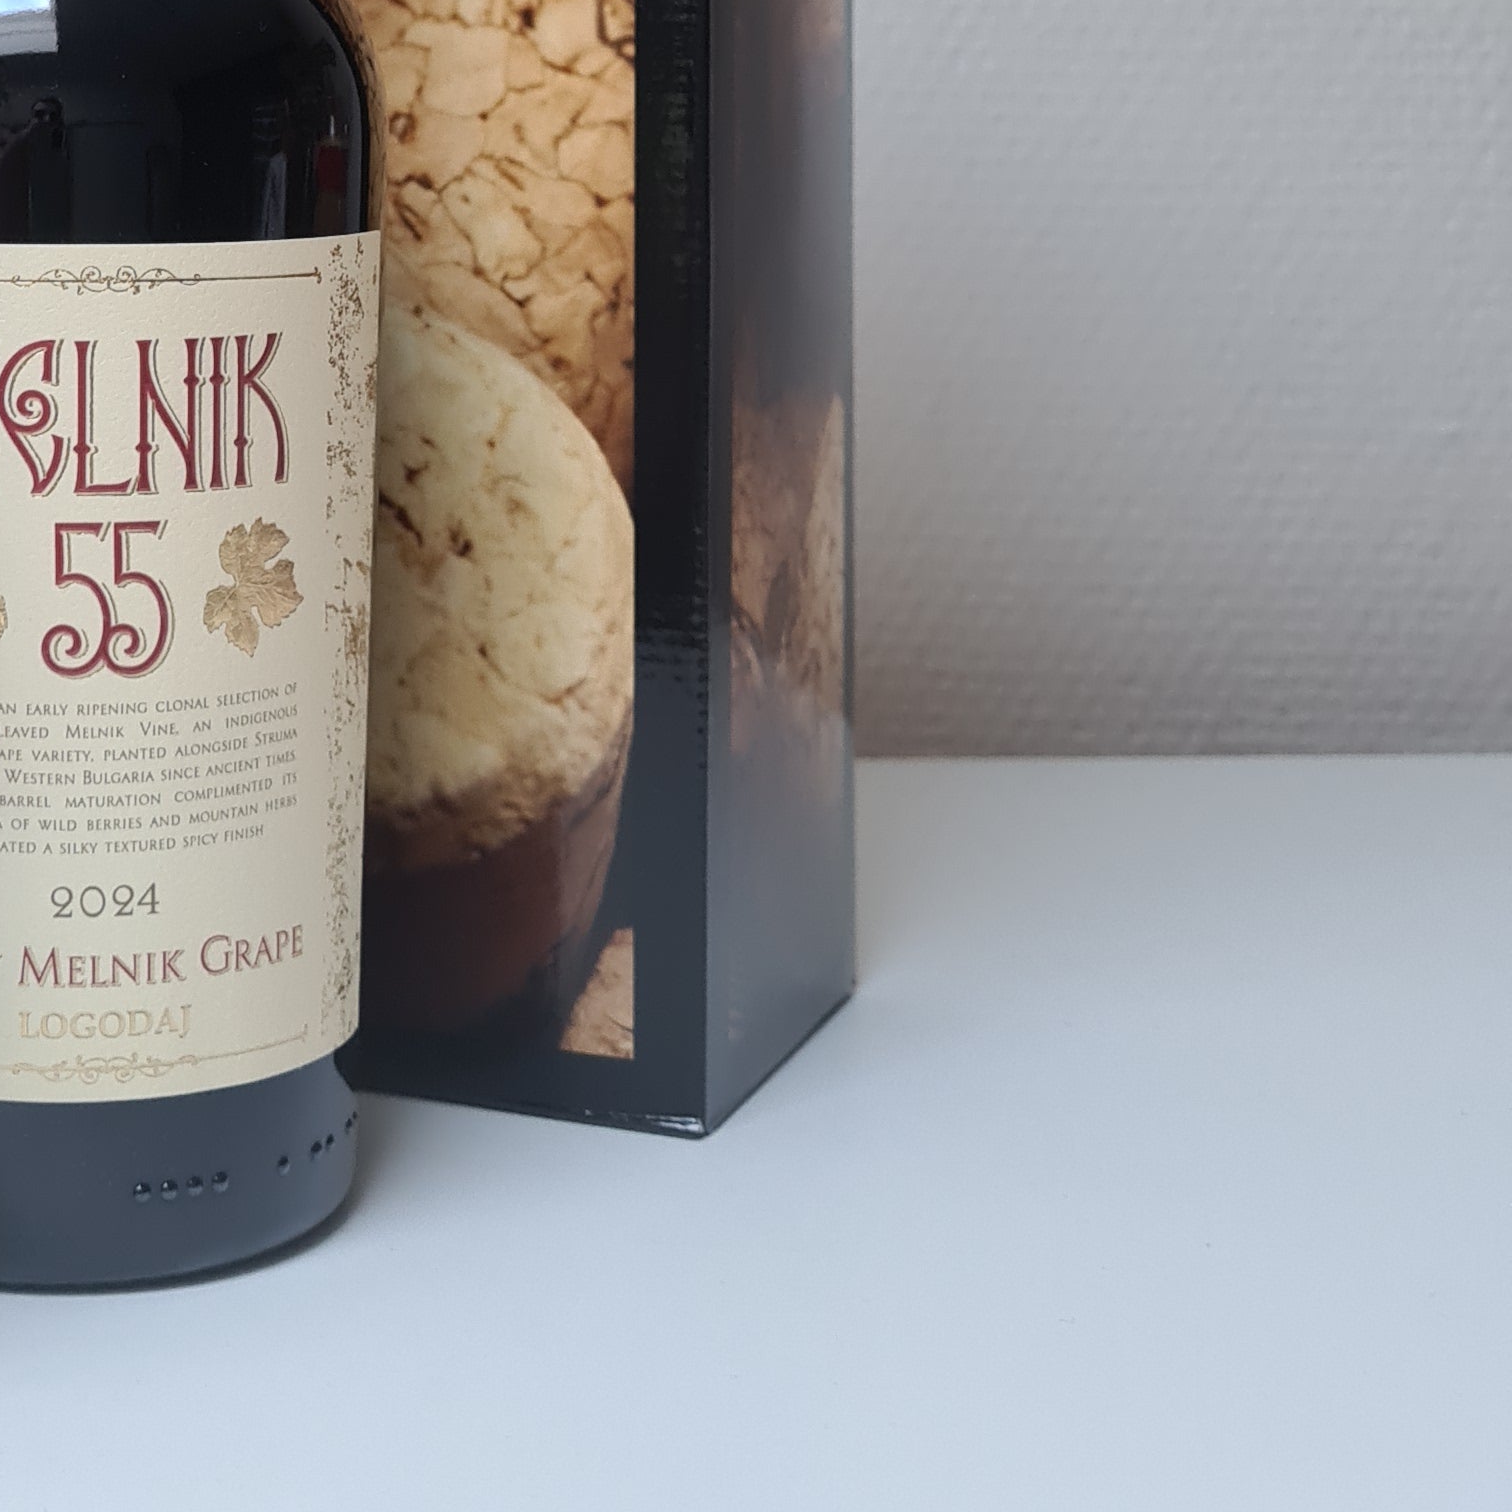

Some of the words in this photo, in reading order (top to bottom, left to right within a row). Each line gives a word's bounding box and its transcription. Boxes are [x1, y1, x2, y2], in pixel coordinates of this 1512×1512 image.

[41, 519, 175, 679] 55
[26, 704, 68, 716] EARLY
[77, 702, 147, 716] RIPENING
[155, 697, 209, 713] CLONAL
[216, 687, 279, 707] SELECTION
[284, 682, 297, 696] OF
[65, 724, 125, 739] MELNIK
[193, 720, 211, 733] AN
[226, 704, 298, 729] INDIGENOUS
[104, 747, 166, 761] PLANTED
[175, 737, 248, 758] ALONGSIDE
[255, 728, 298, 747] STRUMA
[4, 768, 75, 785] WESTERN
[83, 769, 154, 785] BULGARIA
[161, 766, 200, 782] SINCE
[206, 758, 261, 777] ANCIENT
[267, 750, 296, 768] TIMES
[0, 795, 51, 808] BARREL
[65, 793, 161, 808] MATURATION
[174, 777, 273, 803] COMPLIMENTED
[282, 771, 297, 786] ITS
[11, 818, 30, 831] OF
[38, 819, 77, 832] WILD
[87, 816, 142, 831] BERRIES
[149, 814, 181, 828] AND
[189, 803, 258, 824] MOUNTAIN
[265, 794, 297, 813] HERBS
[43, 842, 53, 854] A
[59, 842, 98, 854] SILKY
[106, 837, 176, 854] TEXTURED
[183, 832, 218, 848] SPICY
[224, 824, 264, 843] FINISH
[50, 883, 160, 918] 2024
[18, 945, 187, 988] MELNIK
[199, 924, 304, 977] GRAPE
[18, 1004, 192, 1039] LOGODAJ
